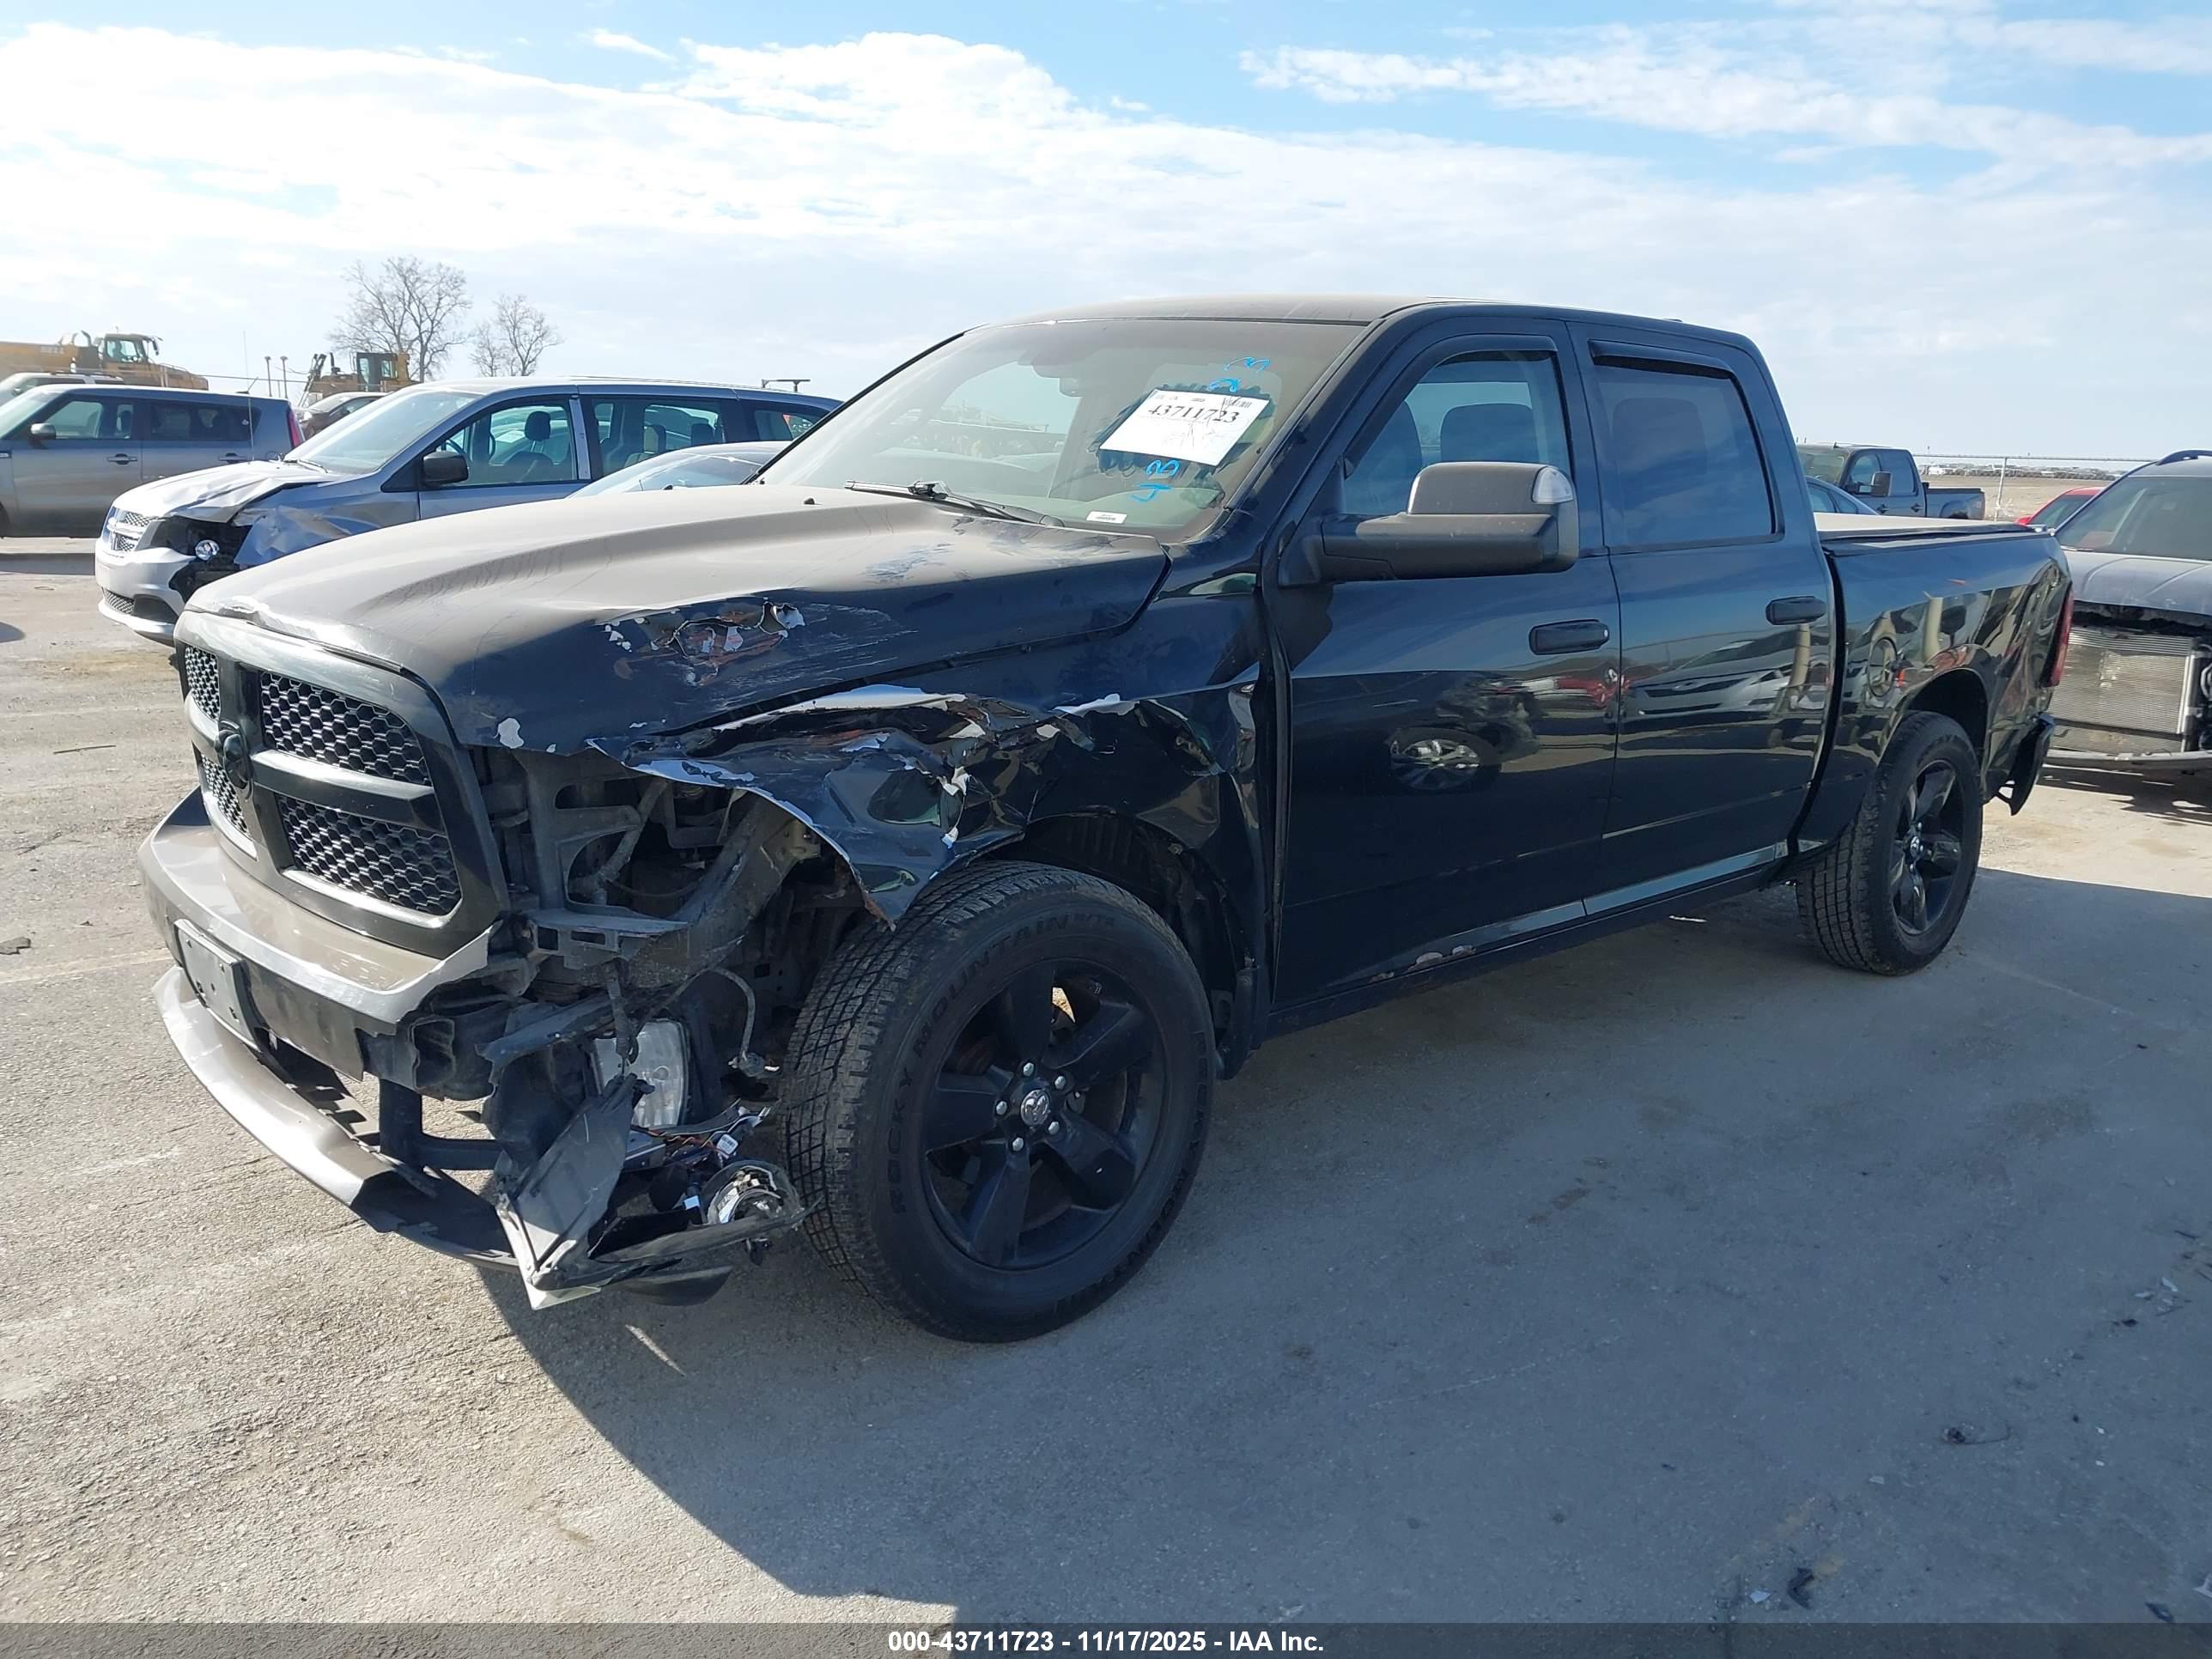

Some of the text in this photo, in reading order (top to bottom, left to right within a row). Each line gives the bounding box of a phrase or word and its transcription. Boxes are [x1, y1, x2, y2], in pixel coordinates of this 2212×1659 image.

[1147, 403, 1240, 423] 43711723
[886, 1065, 915, 1215] ROCKY
[912, 914, 1070, 1058] MOUNTAIN
